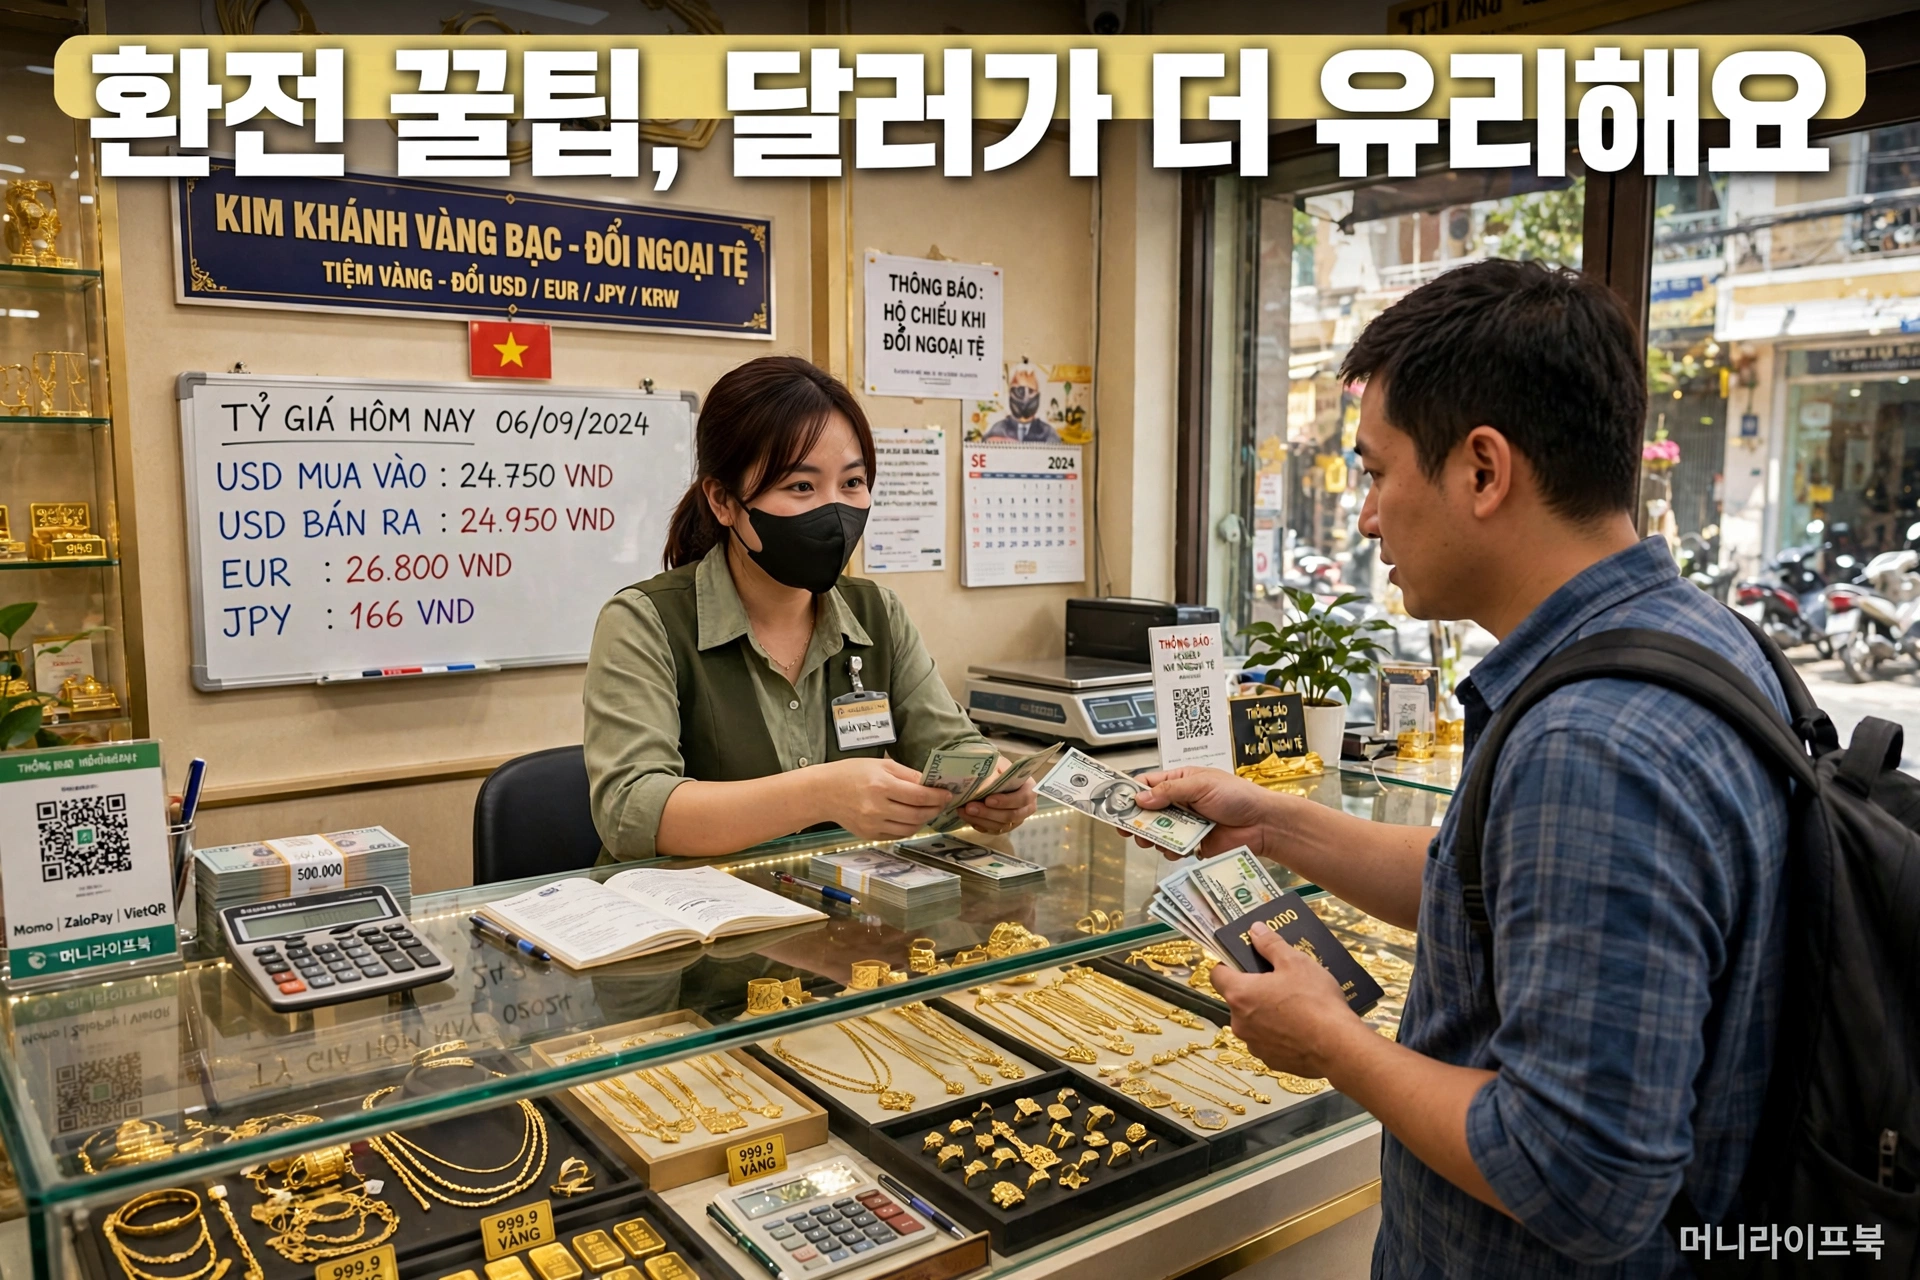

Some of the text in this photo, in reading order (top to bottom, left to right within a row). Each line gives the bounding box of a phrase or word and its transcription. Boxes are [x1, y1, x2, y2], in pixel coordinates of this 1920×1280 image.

[216, 193, 284, 237] KIM
[294, 197, 408, 248] KHÁNH
[415, 207, 497, 256] VÀNG
[505, 222, 562, 267] BẠC
[584, 217, 631, 268] ĐỔI
[637, 236, 713, 282] NGOẠI
[719, 239, 749, 285] TỆ
[322, 257, 374, 289] TIỆM
[378, 261, 433, 291] VÀNG
[450, 263, 484, 295] ĐỔI
[489, 274, 527, 297] USD
[544, 278, 579, 301] EUR
[594, 283, 627, 305] JPY
[641, 287, 679, 309] KRW
[888, 271, 942, 296] THÔNG
[884, 299, 986, 329] HỘ CHIẾU KHI
[915, 335, 963, 359] NGOẠI
[967, 335, 985, 361] TỆ
[221, 391, 650, 440] TỶ GIÁ HÔM NAY 06/09/2024
[217, 461, 282, 491] USD
[298, 462, 361, 489] MUA
[373, 453, 427, 489] VÀO
[460, 461, 556, 488] 24.750
[564, 463, 613, 488] VND
[1047, 456, 1075, 470] 2024
[219, 510, 286, 540] USD
[303, 499, 365, 538] BÁN
[382, 508, 421, 536] RA
[460, 507, 557, 533] 24.950
[566, 507, 615, 532] VND
[222, 557, 291, 589] EUR
[347, 554, 449, 584] 26.800
[459, 552, 512, 578] VND
[223, 604, 291, 637] JPY
[350, 600, 403, 629] 166
[417, 598, 474, 625] VND
[297, 862, 342, 881] 500.000
[13, 922, 54, 937] Momo
[64, 911, 113, 929] ZaloPay
[124, 902, 167, 920] VietQR
[60, 935, 152, 964] 머니라이프북
[739, 1142, 773, 1162] 999.9
[497, 1210, 538, 1233] 999.9
[333, 1255, 380, 1280] 999.9
